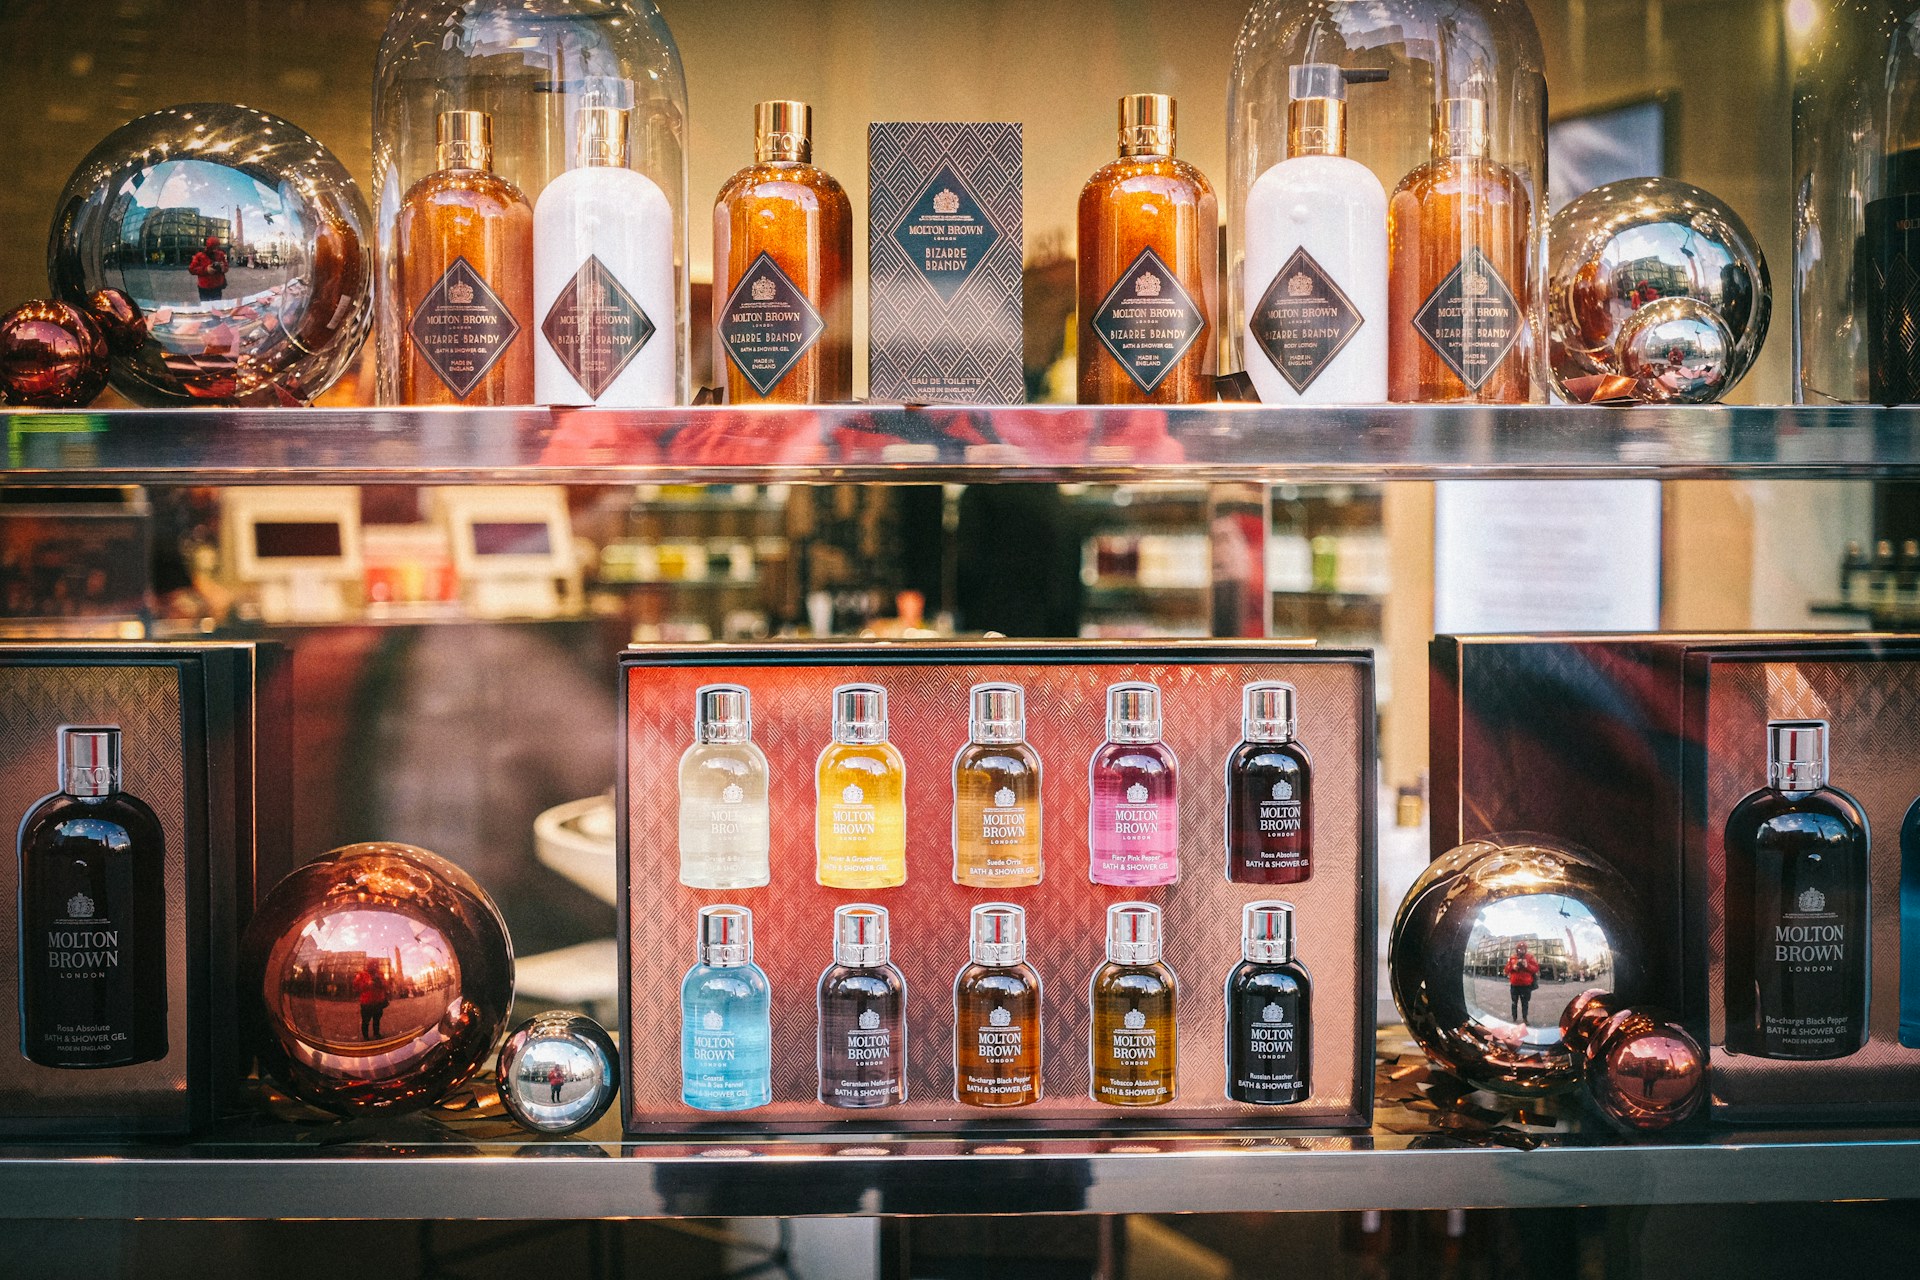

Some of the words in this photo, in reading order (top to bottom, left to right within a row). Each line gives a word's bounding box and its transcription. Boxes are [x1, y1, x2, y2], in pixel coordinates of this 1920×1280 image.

[909, 226, 945, 234] MOLTON
[948, 226, 983, 234] BROWN
[926, 248, 967, 258] BIZARRE
[926, 261, 967, 270] BRANDY
[732, 313, 762, 322] MOLTON
[766, 312, 800, 321] BROWN
[1113, 309, 1146, 318] MOLTON
[1150, 309, 1184, 318] BROWN
[1268, 309, 1299, 319] MOLTON
[1302, 308, 1338, 317] BROWN
[1477, 308, 1509, 317] BROWN
[427, 316, 460, 325] MOLTON
[463, 315, 497, 324] BROWN
[596, 316, 630, 324] BROWN
[731, 333, 761, 343] BIZARRE
[766, 333, 802, 342] BRANDY
[1111, 330, 1145, 339] BIZARRE
[1150, 329, 1186, 339] BRANDY
[1265, 329, 1298, 340] BIZARRE
[1303, 329, 1340, 338] BRANDY
[1478, 329, 1510, 338] BRANDY
[425, 335, 459, 344] BIZARRE
[464, 335, 499, 344] BRANDY
[559, 335, 591, 345] BIZARRE
[596, 336, 632, 345] BRANDY
[833, 811, 874, 822] MOLTON
[1116, 810, 1158, 820] MOLTON
[1260, 807, 1301, 818] MOLTON
[983, 814, 1024, 825] MOLTON
[1260, 819, 1300, 830] BROWN
[833, 824, 874, 834] BROWN
[983, 827, 1024, 837] BROWN
[1115, 823, 1158, 833] BROWN
[1272, 860, 1300, 868] SHOWER
[1776, 925, 1844, 942] MOLTON
[48, 931, 118, 949] MOLTON
[1775, 944, 1843, 962] BROWN
[50, 950, 118, 968] BROWN
[1766, 1016, 1804, 1026] Re-charge
[1827, 1017, 1848, 1025] Pepper
[76, 1024, 110, 1032] Absolute
[1767, 1026, 1789, 1034] BATH
[1799, 1027, 1834, 1035] SHOWER
[1835, 1026, 1847, 1034] GEL
[45, 1034, 62, 1042] BATH
[979, 1033, 1021, 1044] MOLTON
[1251, 1029, 1293, 1040] MOLTON
[694, 1037, 734, 1048] MOLTON
[848, 1035, 889, 1047] MOLTON
[1114, 1036, 1156, 1046] MOLTON
[979, 1045, 1021, 1056] BROWN
[1251, 1041, 1293, 1052] BROWN
[694, 1049, 734, 1060] BROWN
[848, 1047, 889, 1059] BROWN
[1114, 1048, 1156, 1059] BROWN
[969, 1076, 995, 1085] Re-charge
[1013, 1076, 1031, 1084] Pepper
[1238, 1080, 1254, 1088] BATH
[835, 1088, 852, 1096] BATH
[967, 1084, 982, 1092] BATH
